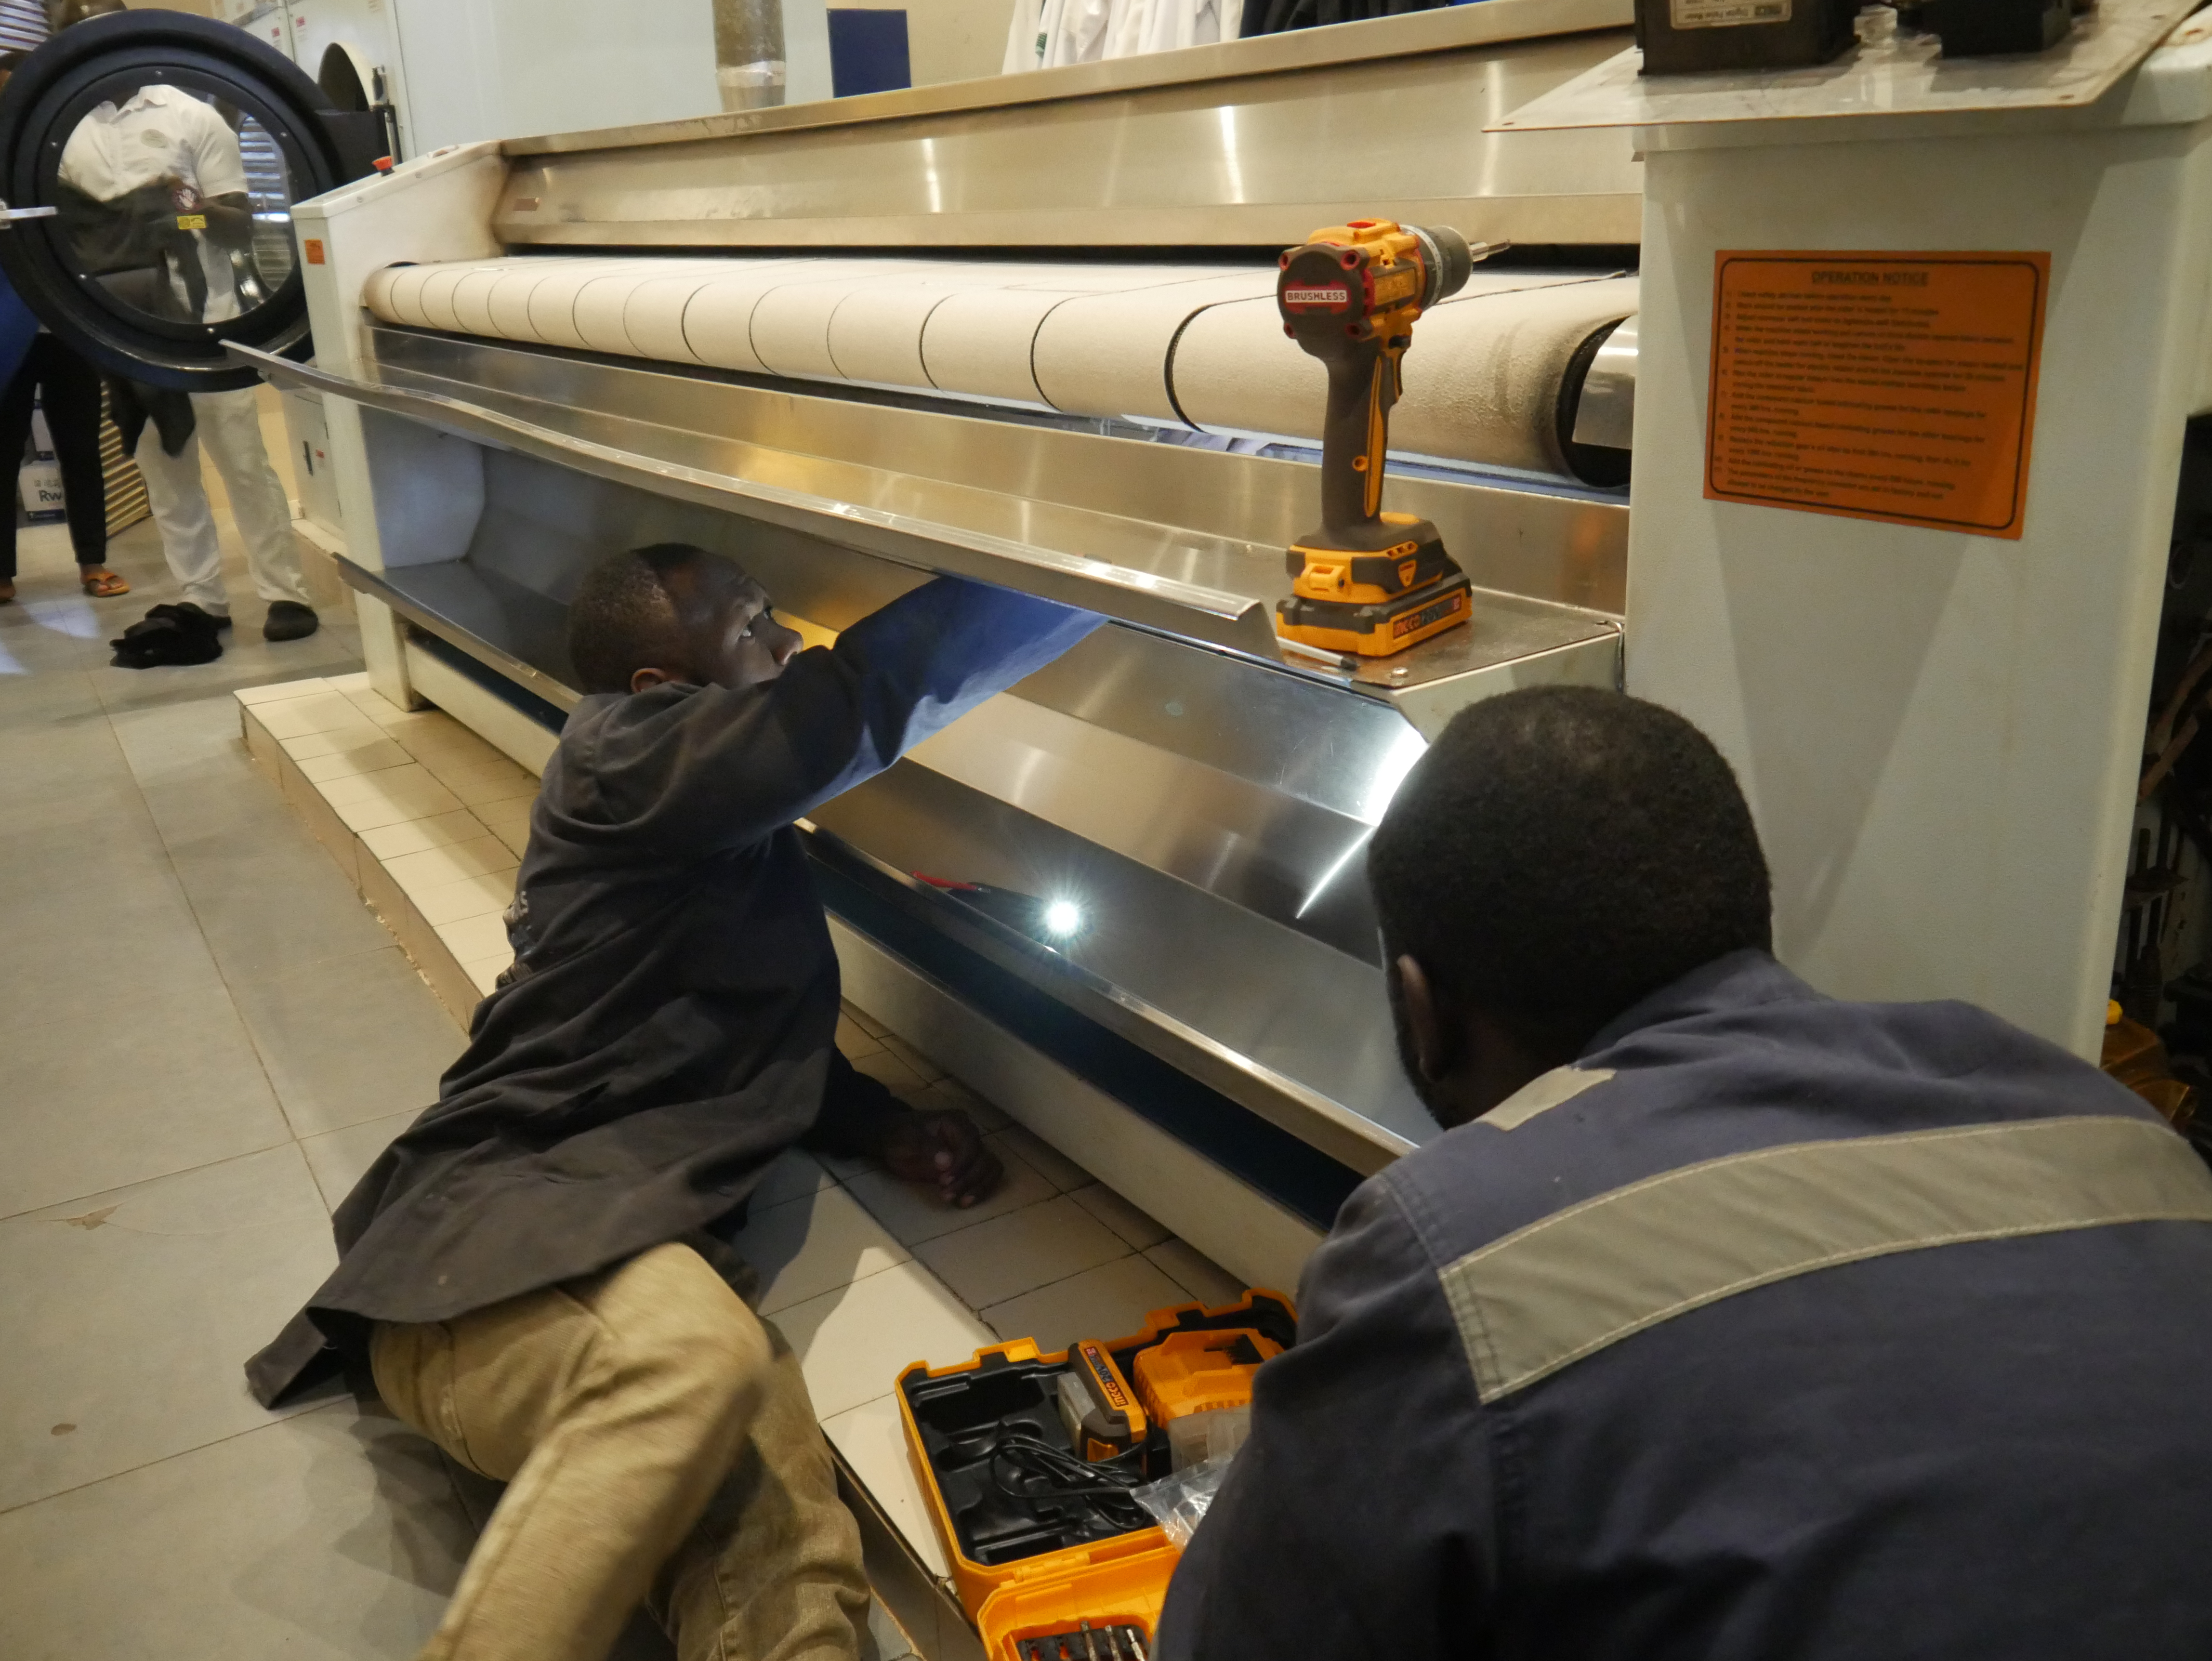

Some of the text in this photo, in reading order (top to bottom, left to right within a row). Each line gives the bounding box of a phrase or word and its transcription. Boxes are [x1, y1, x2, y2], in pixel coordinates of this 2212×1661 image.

[1811, 271, 1928, 287] OPERATION NOTICE
[1287, 292, 1345, 301] BRUSHLESS
